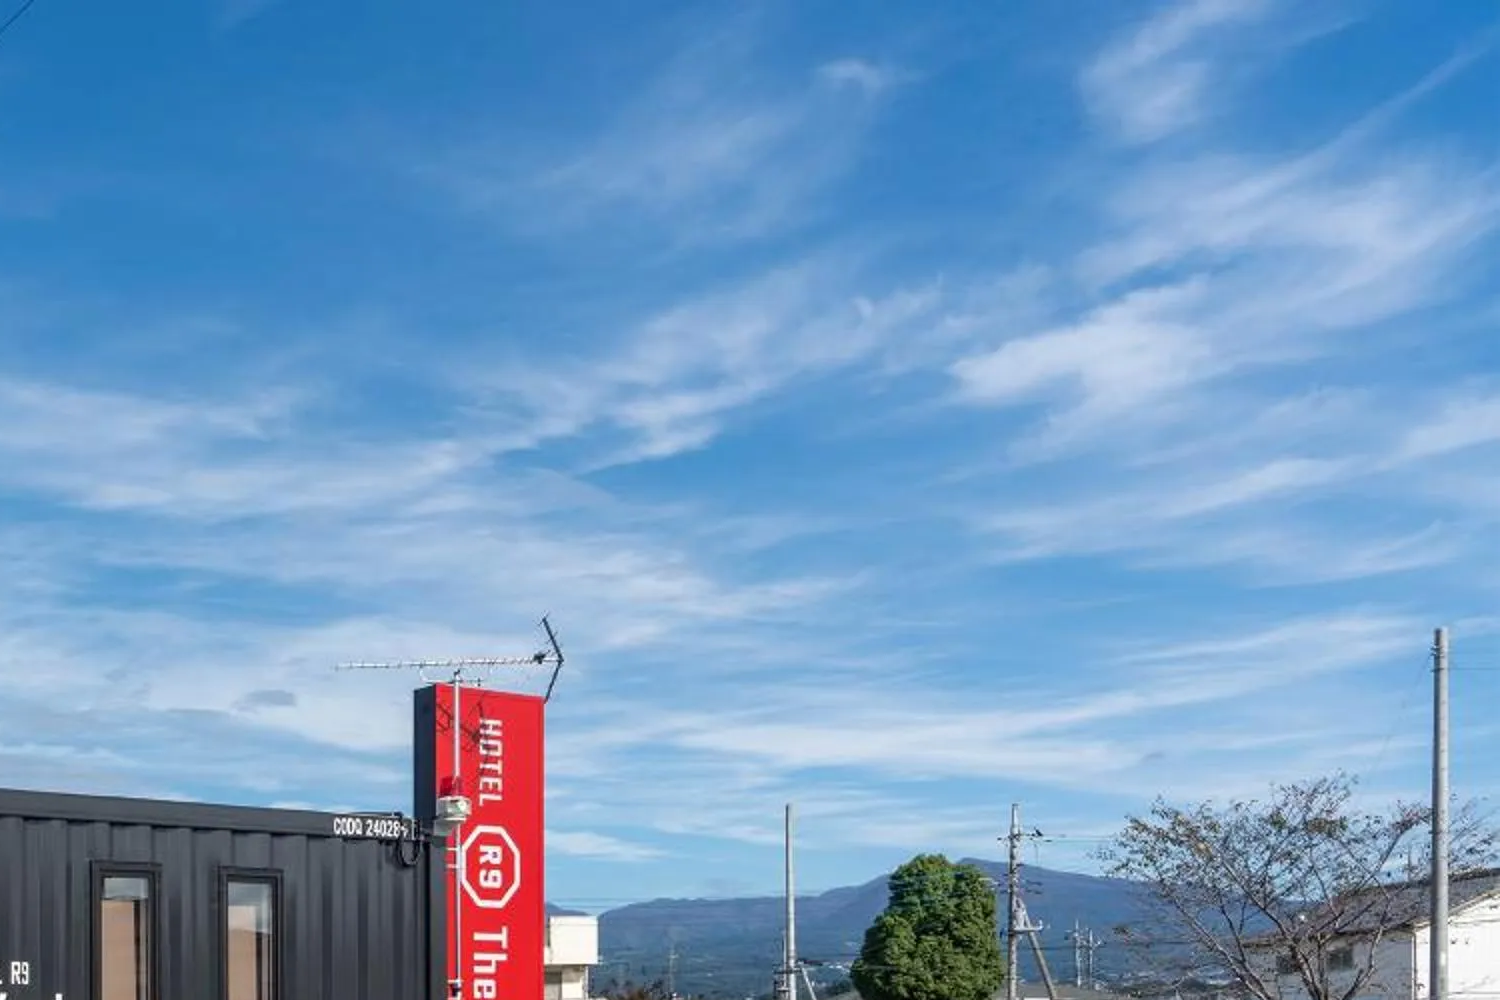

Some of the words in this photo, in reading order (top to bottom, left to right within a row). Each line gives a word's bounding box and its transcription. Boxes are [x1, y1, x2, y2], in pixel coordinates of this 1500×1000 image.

[479, 717, 503, 807] HOTEL
[478, 846, 503, 889] R9
[10, 961, 29, 985] R9
[472, 927, 508, 999] The
